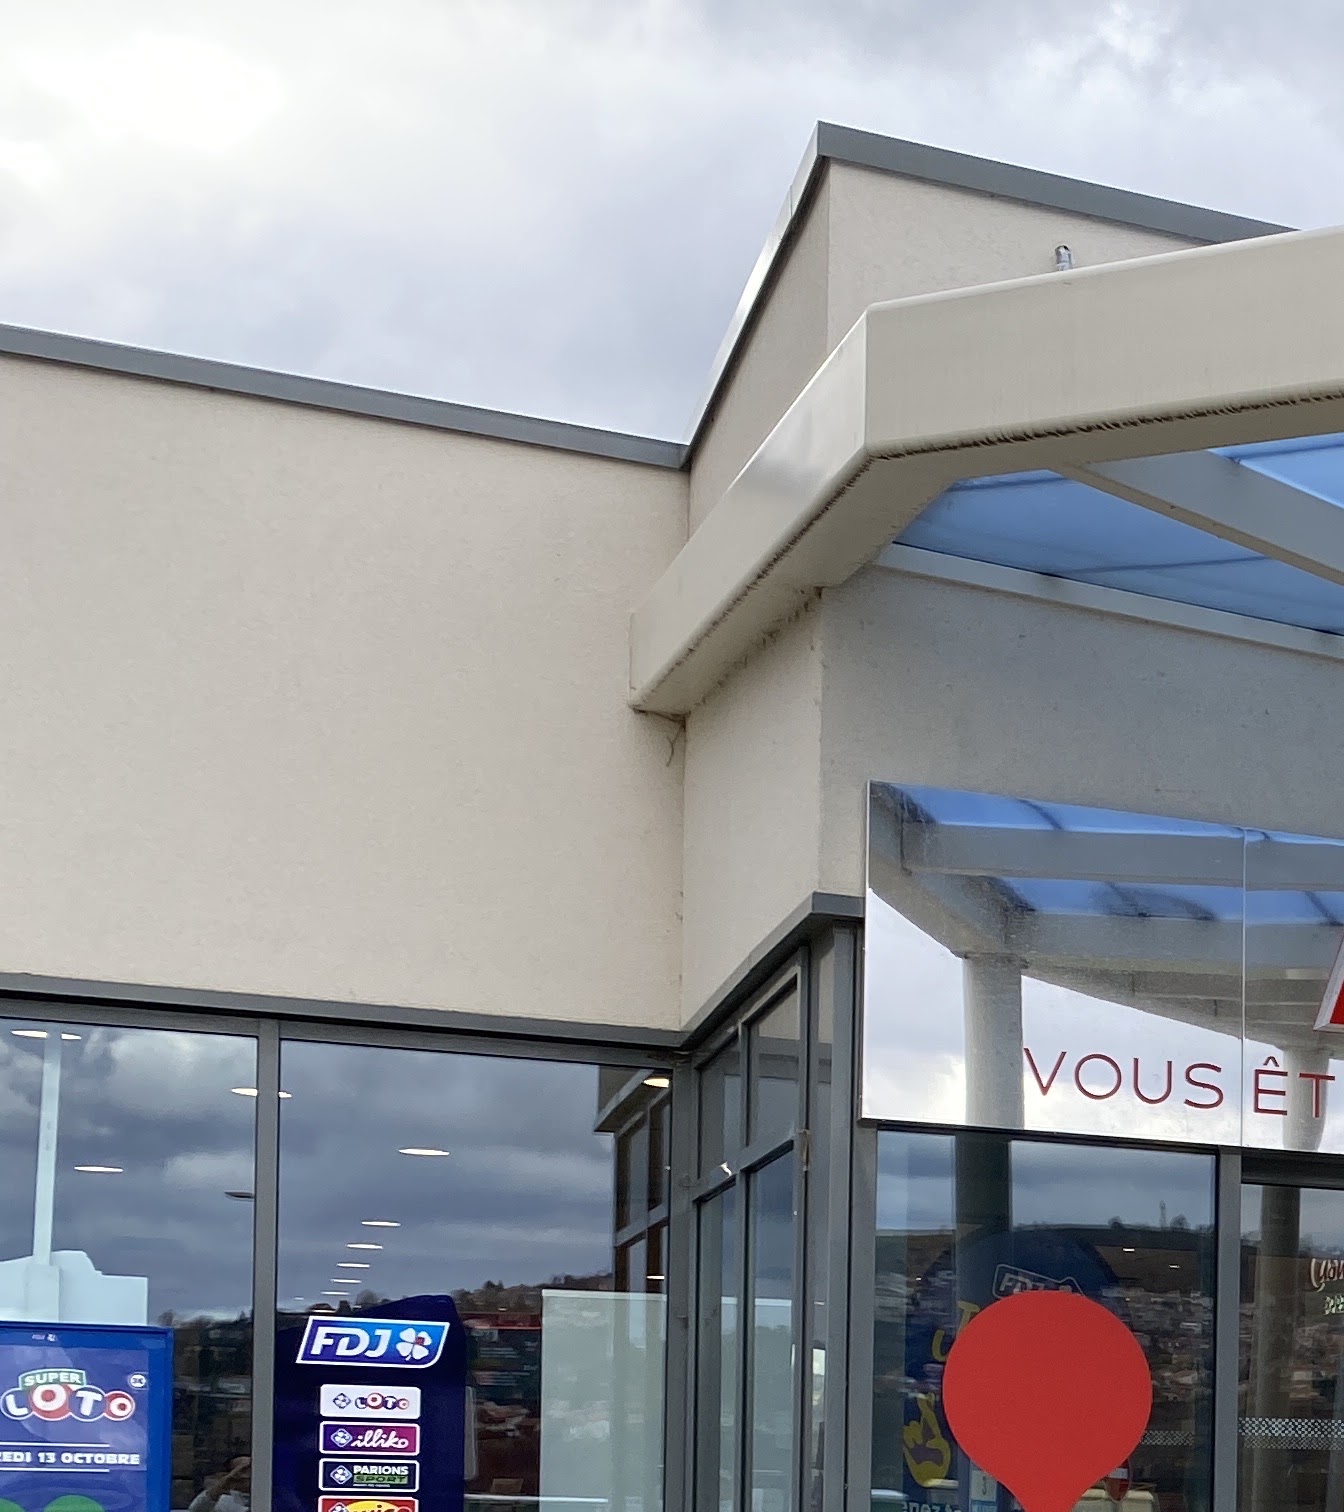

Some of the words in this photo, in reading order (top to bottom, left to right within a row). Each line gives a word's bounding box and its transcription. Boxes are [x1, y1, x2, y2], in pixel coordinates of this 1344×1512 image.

[1023, 1047, 1224, 1109] VOUS
[310, 1326, 393, 1358] FDJ
[24, 1371, 82, 1386] SUPER
[3, 1384, 134, 1419] LOTO
[354, 1392, 410, 1410] LOTO
[351, 1429, 410, 1448] illiko
[38, 1452, 56, 1462] 13
[61, 1452, 140, 1465] OCTOBRE
[353, 1465, 409, 1475] PARIONS
